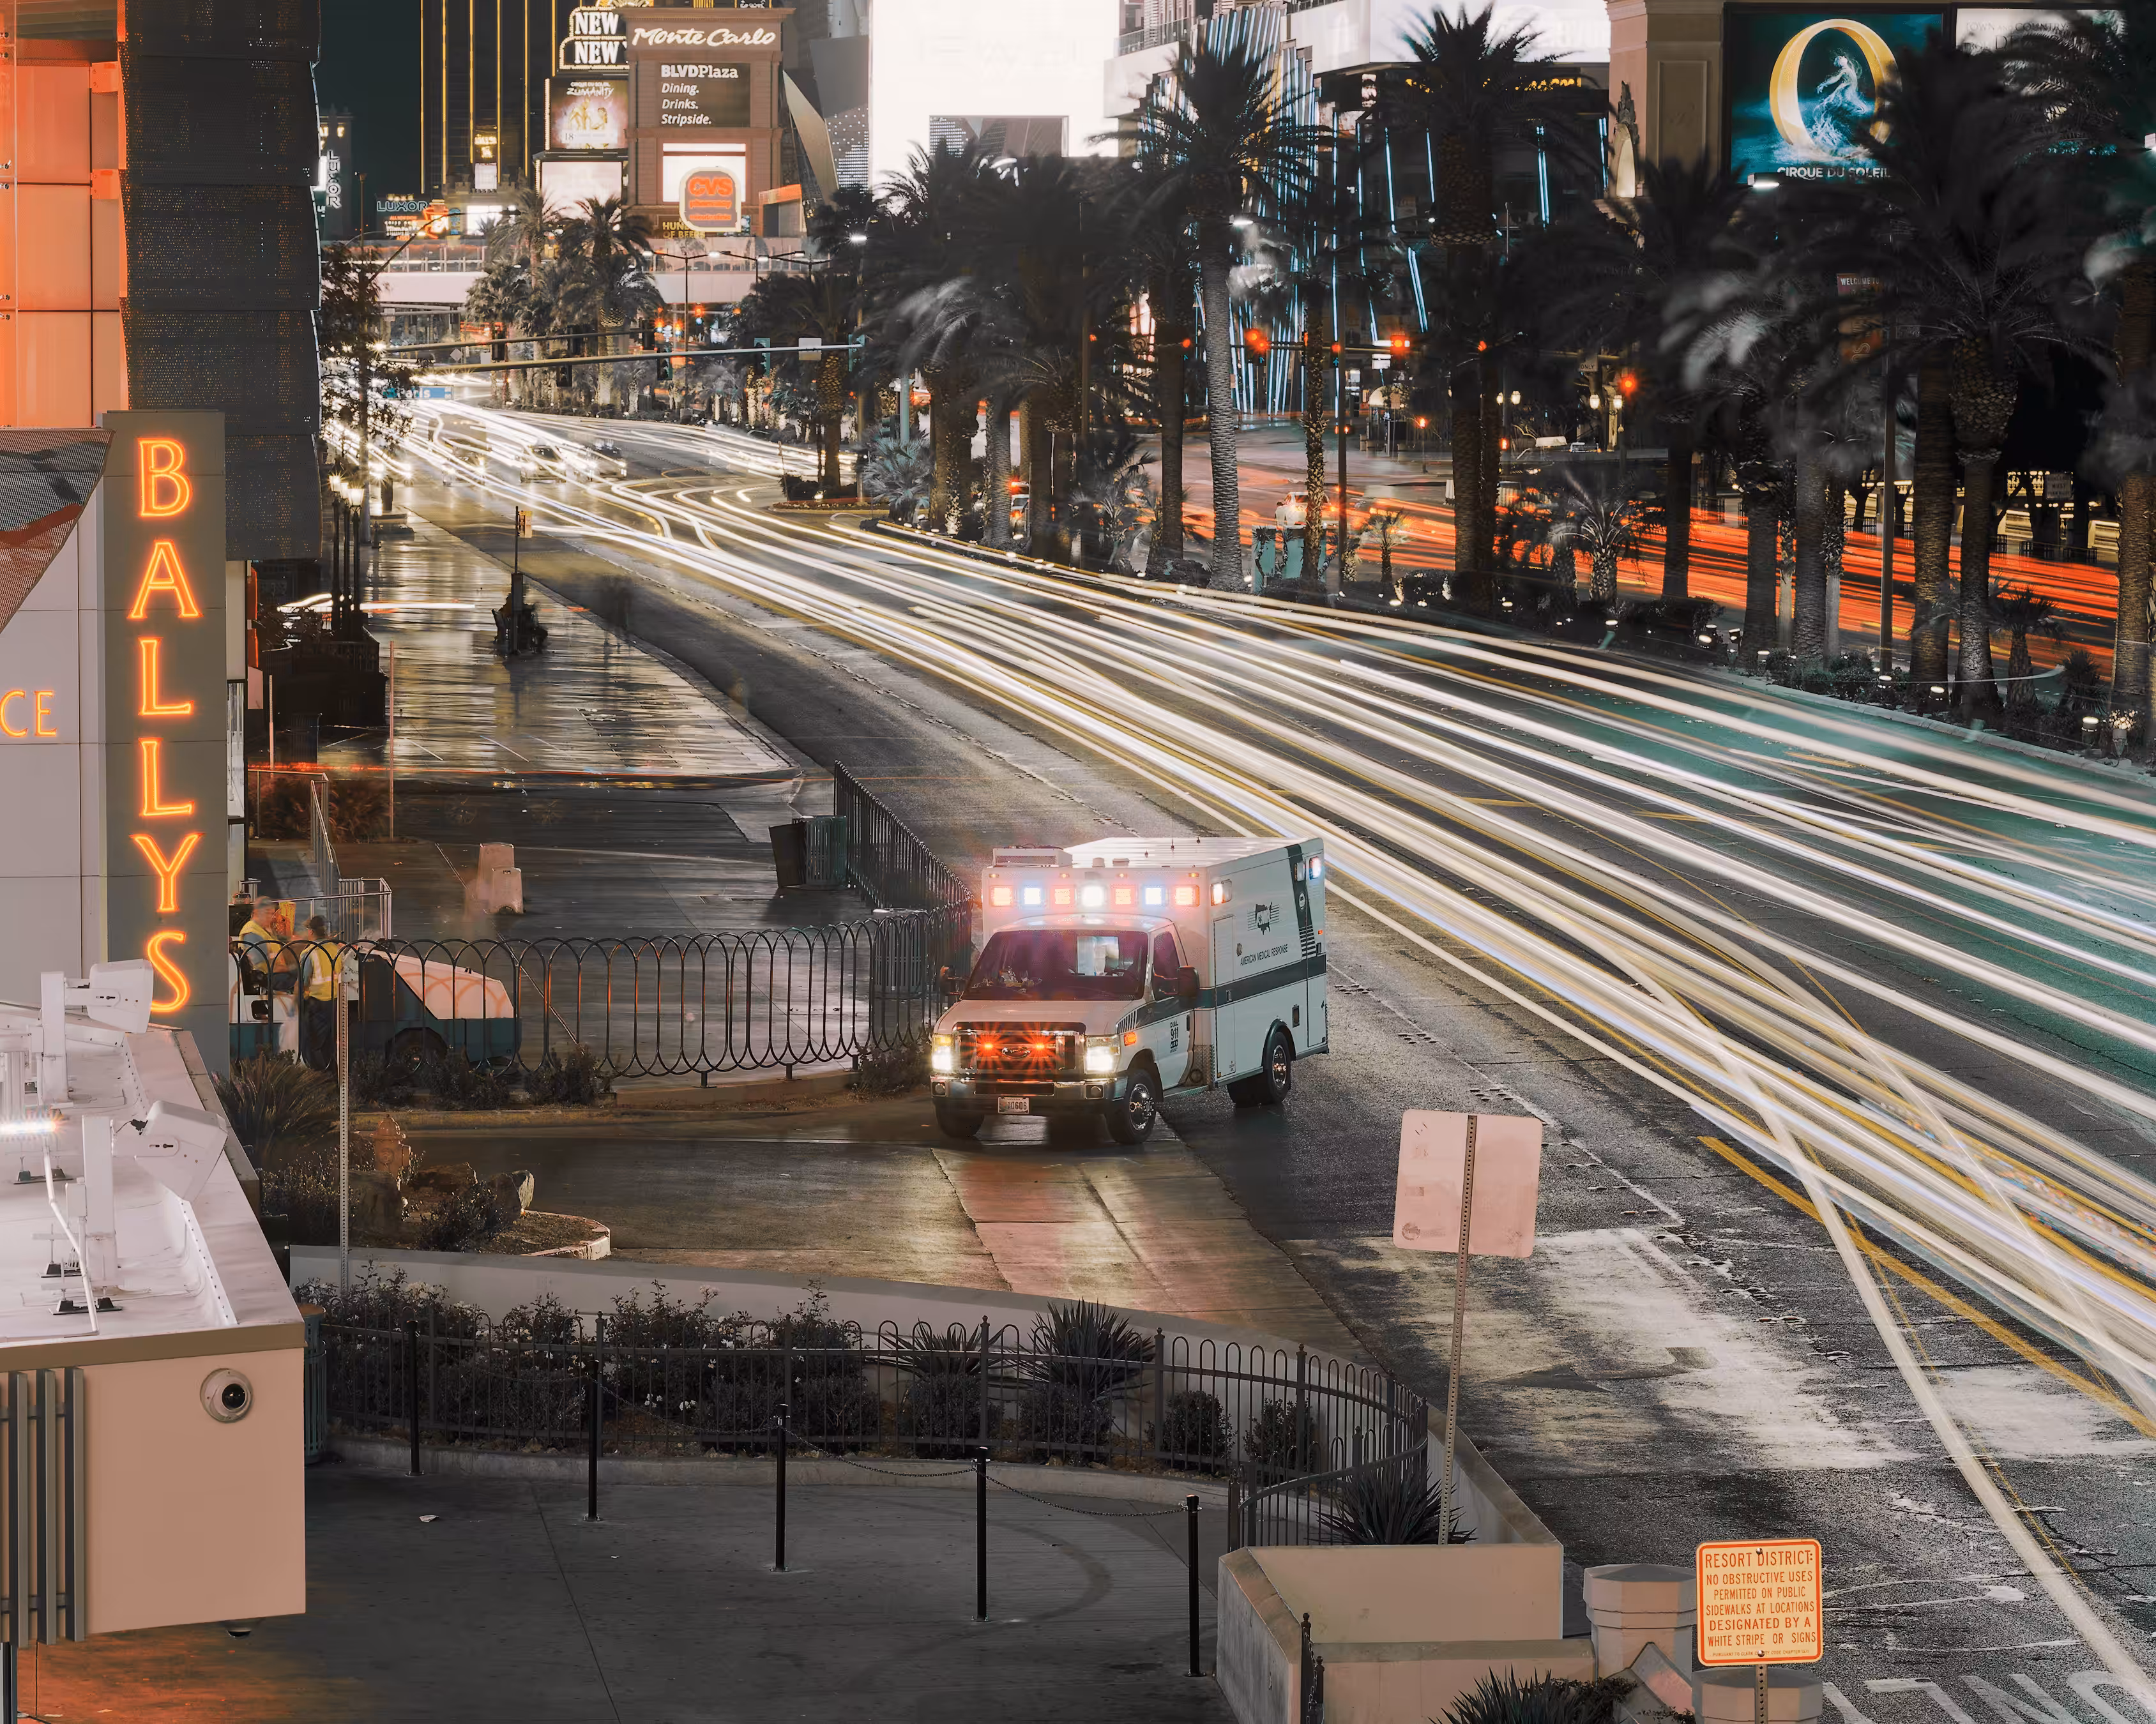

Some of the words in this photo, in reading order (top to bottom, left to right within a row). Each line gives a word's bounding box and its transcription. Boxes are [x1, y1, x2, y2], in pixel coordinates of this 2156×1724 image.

[574, 12, 619, 34] NEW
[632, 27, 707, 46] Monte
[706, 27, 776, 47] Carlo
[574, 41, 618, 64] NEW
[661, 64, 739, 79] BLVDPlaza
[566, 86, 614, 100] ZUMANITY
[661, 83, 700, 96] Dining.
[661, 99, 699, 110] Drinks.
[661, 114, 712, 127] Stripside.
[326, 149, 342, 209] LUXOR
[1777, 167, 1824, 181] CIRQUE
[1827, 167, 1845, 178] DU
[688, 176, 734, 197] CVS
[377, 200, 429, 212] LUXOR
[1840, 277, 1871, 285] WELCOME
[397, 388, 430, 398] Paris
[127, 436, 204, 1013] BALLYS
[1240, 956, 1257, 965] AMERICAN
[1257, 951, 1271, 962] MEDICAL
[1271, 944, 1288, 957] RESPONSE
[1171, 1027, 1179, 1040] 911
[1011, 1101, 1027, 1110] 0606
[1705, 1553, 1752, 1568] RESORT
[1757, 1550, 1812, 1566] DISTRICT:
[1706, 1574, 1719, 1585] NO
[1722, 1571, 1785, 1585] OBSTRUCTIVE
[1789, 1571, 1812, 1582] USES
[1714, 1588, 1756, 1600] PERMITTED
[1762, 1587, 1772, 1598] ON
[1777, 1586, 1805, 1598] PUBLIC
[1706, 1603, 1751, 1616] SIDEWALKS
[1756, 1603, 1765, 1614] AT
[1770, 1601, 1814, 1613] LOCATIONS
[1710, 1617, 1779, 1631] DESIGNATED
[1785, 1617, 1799, 1628] BY
[1804, 1617, 1811, 1628] A
[1708, 1635, 1732, 1647] WHITE
[1736, 1633, 1765, 1645] STRIPE
[1773, 1633, 1784, 1644] OR
[1791, 1631, 1816, 1644] SIGNS
